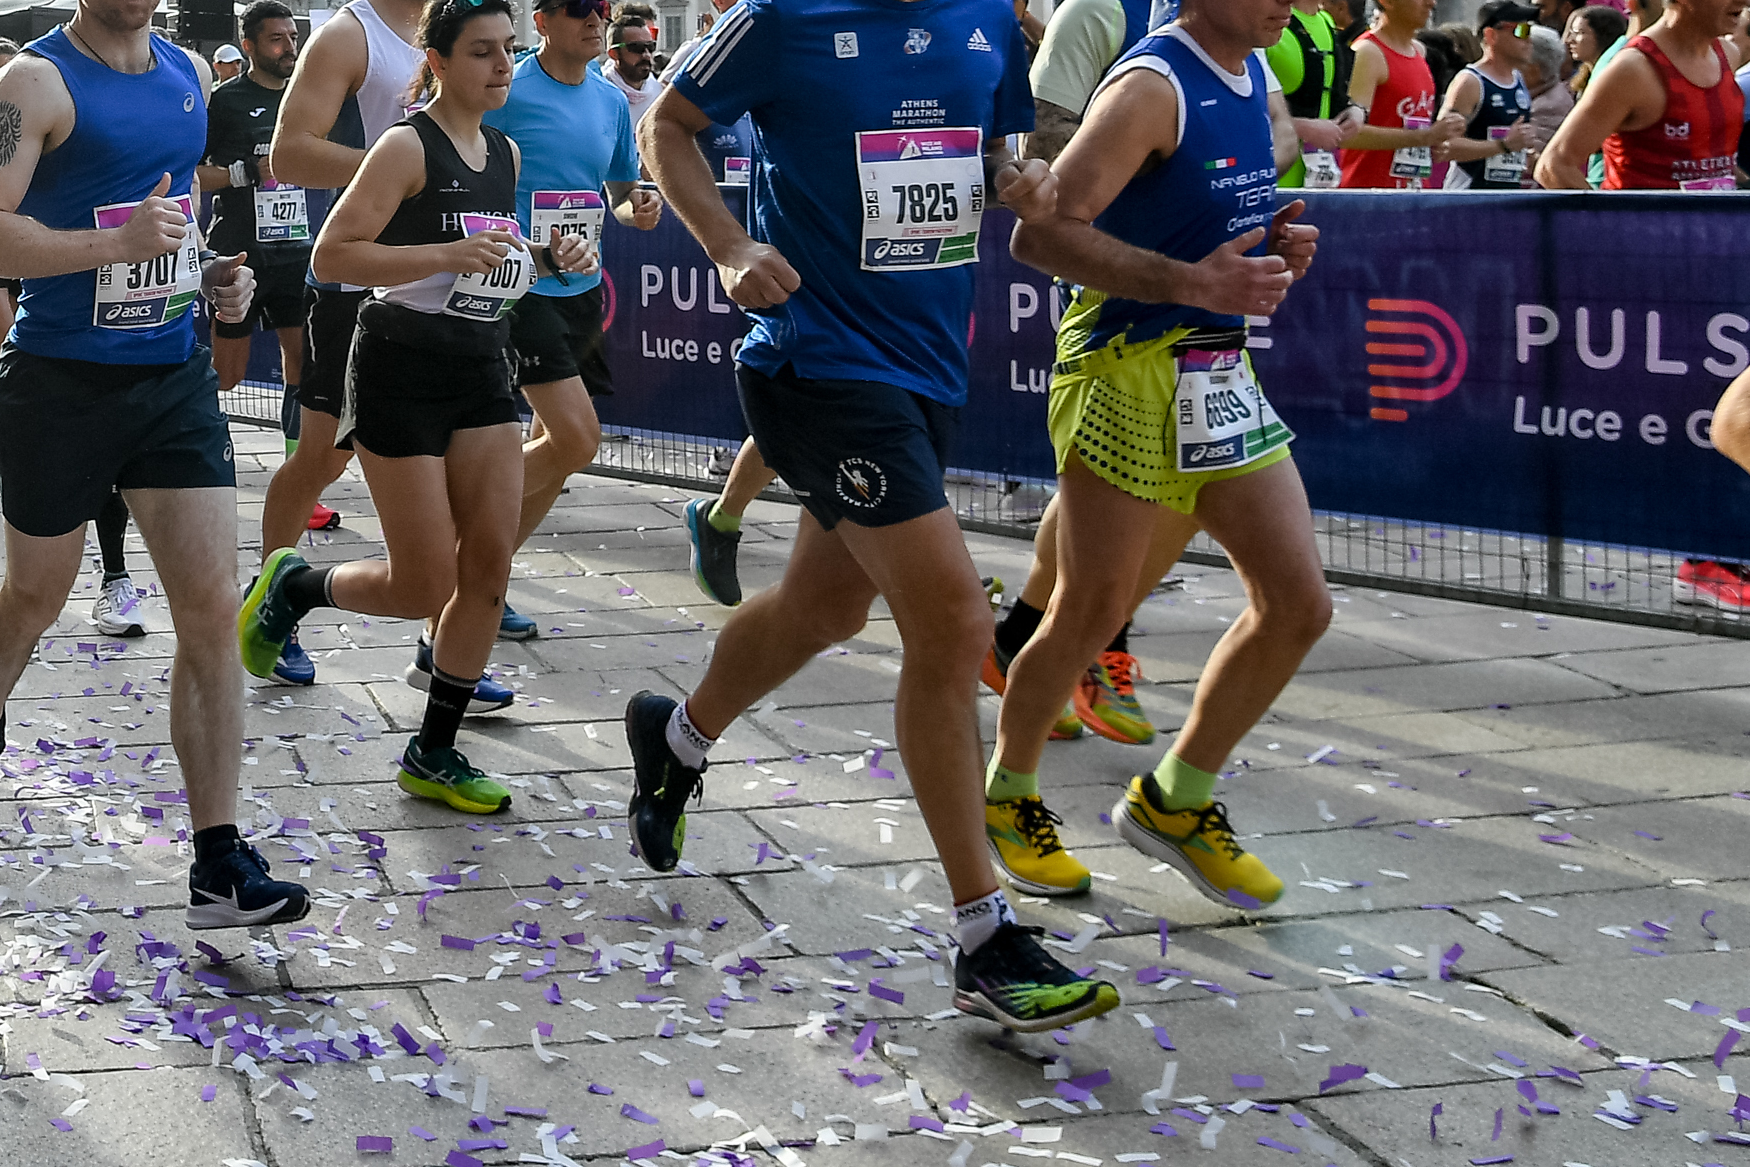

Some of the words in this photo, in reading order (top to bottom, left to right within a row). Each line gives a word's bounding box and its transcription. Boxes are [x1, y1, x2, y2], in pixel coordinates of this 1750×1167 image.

[967, 42, 992, 52] adidas
[900, 99, 939, 109] ATHENS
[891, 108, 947, 119] MARATHON
[271, 201, 298, 221] 4277
[891, 182, 959, 225] 7825
[890, 242, 925, 256] asics
[639, 264, 731, 314] PUL
[121, 305, 152, 318] asics
[468, 299, 493, 311] asics
[641, 330, 699, 362] Luce
[706, 341, 722, 364] e
[1009, 359, 1052, 394] Lu
[1512, 395, 1623, 442] Luce
[1638, 413, 1669, 446] e
[1206, 442, 1236, 459] asics
[845, 457, 863, 466] TCS
[864, 459, 883, 474] NEW
[878, 474, 888, 498] YORK
